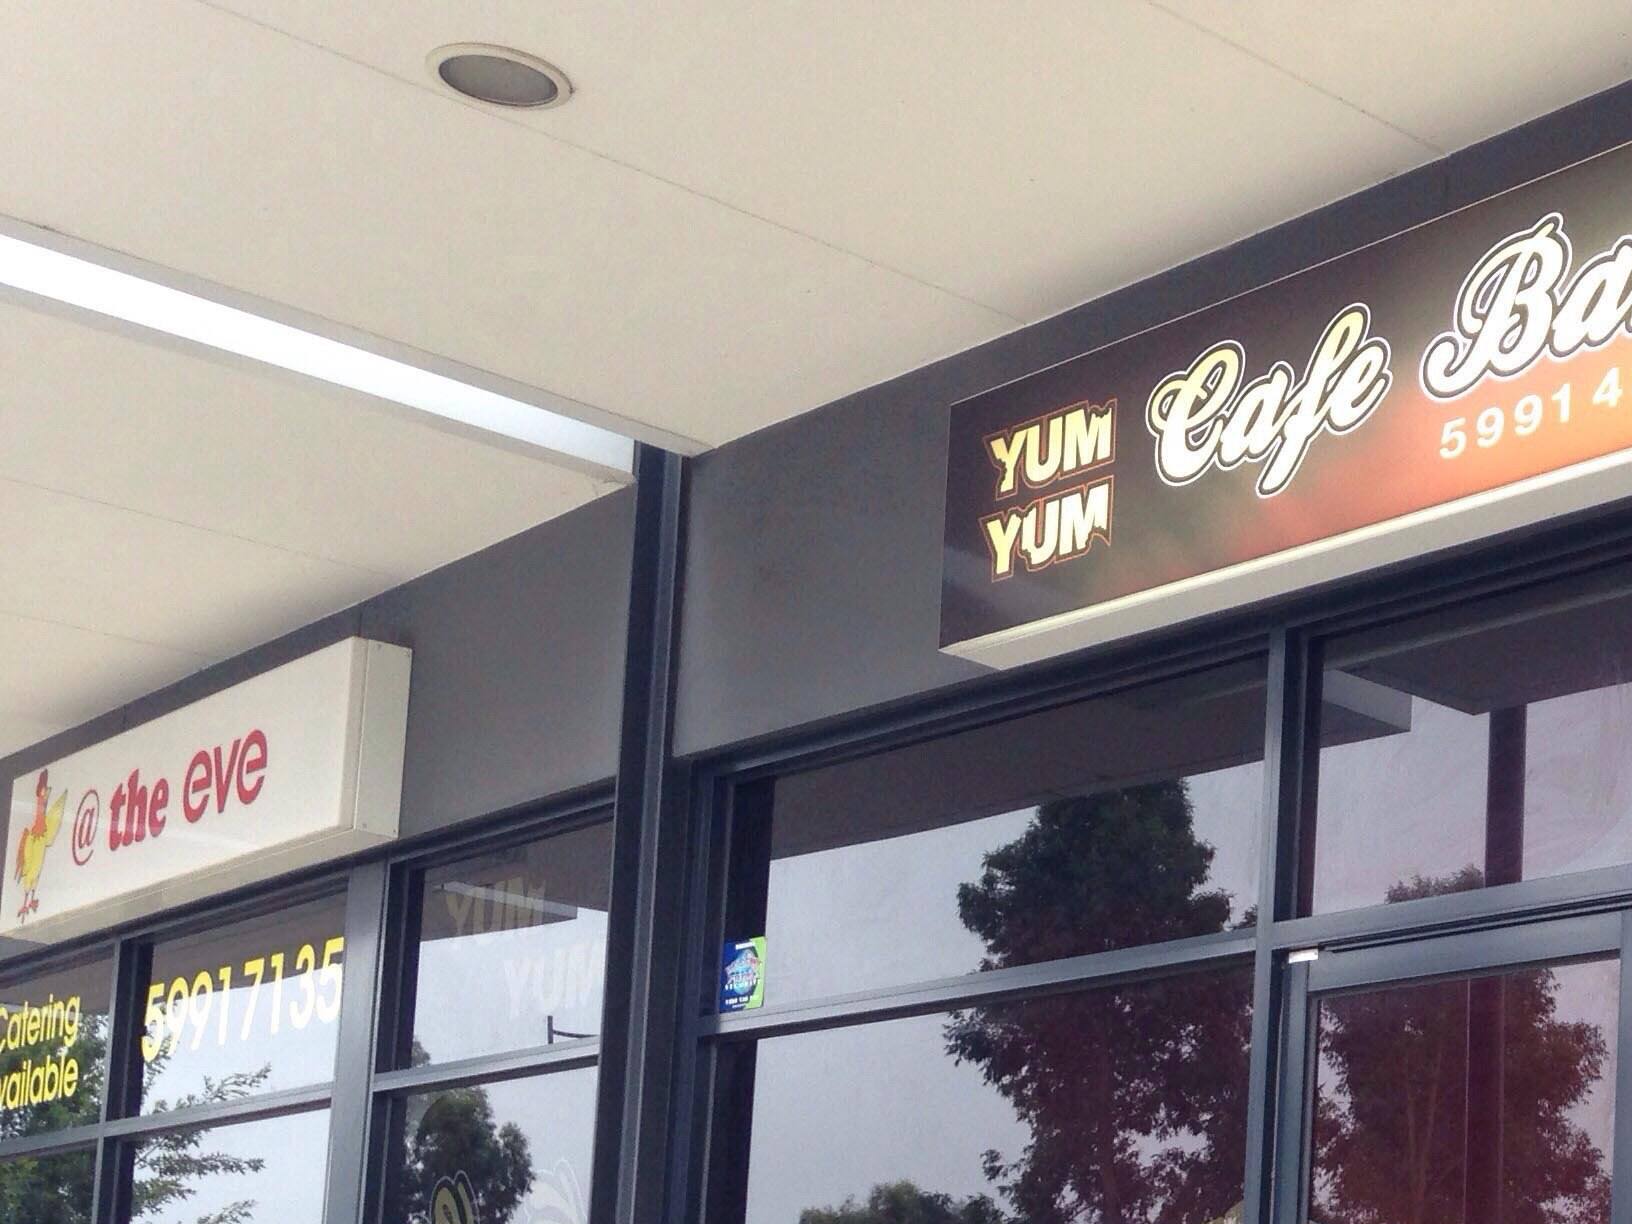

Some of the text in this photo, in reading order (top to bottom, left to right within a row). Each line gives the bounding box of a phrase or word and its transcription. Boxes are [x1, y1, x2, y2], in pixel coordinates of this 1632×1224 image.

[1149, 304, 1391, 496] Cafe
[1439, 383, 1571, 459] 5991
[987, 402, 1115, 495] YUM
[983, 479, 1112, 577] YUM
[72, 728, 268, 866] @ the eve
[0, 994, 81, 1049] Catering
